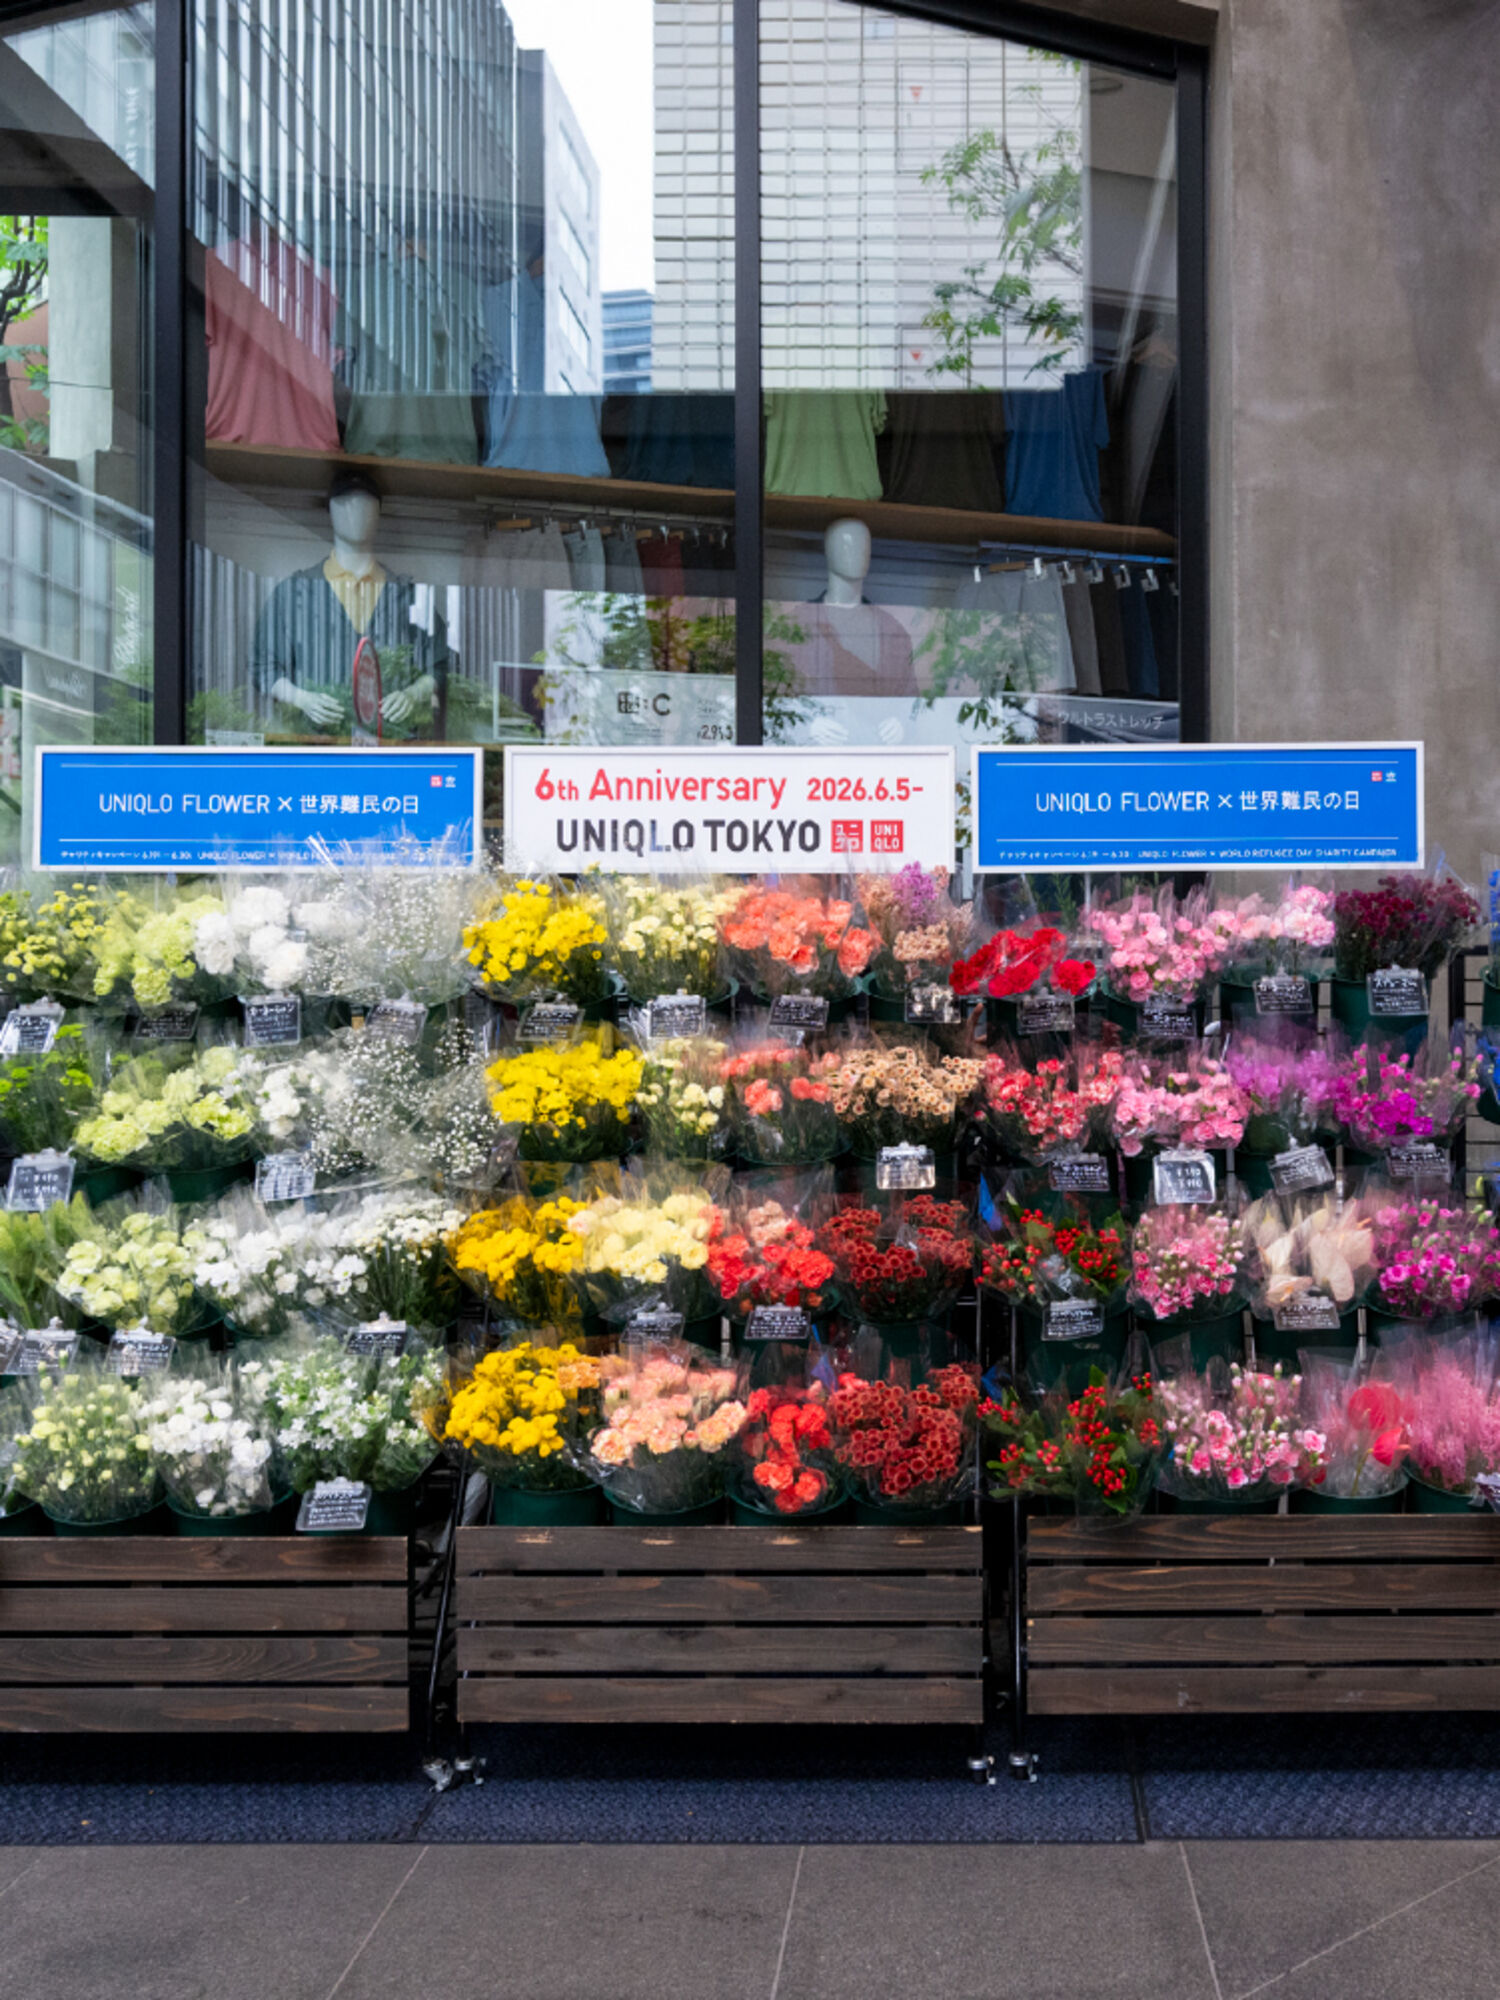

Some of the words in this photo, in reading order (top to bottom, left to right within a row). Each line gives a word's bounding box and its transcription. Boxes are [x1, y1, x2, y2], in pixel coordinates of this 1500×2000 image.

[1058, 711, 1164, 730] ウルトラストレッチ
[535, 768, 580, 801] 6th
[588, 768, 787, 810] Anniversary
[806, 777, 924, 802] 2026.6.5-
[99, 793, 173, 815] UNIQLO
[182, 794, 270, 814] FLOWER
[300, 794, 419, 815] 世界難民の日
[1036, 792, 1112, 814] UNIQLO
[1121, 791, 1210, 812] FLOWER
[1240, 790, 1360, 812] 世界難民の日
[556, 819, 695, 857] UNIQLO
[702, 819, 821, 853] TOKYO
[1219, 848, 1250, 858] WORLD
